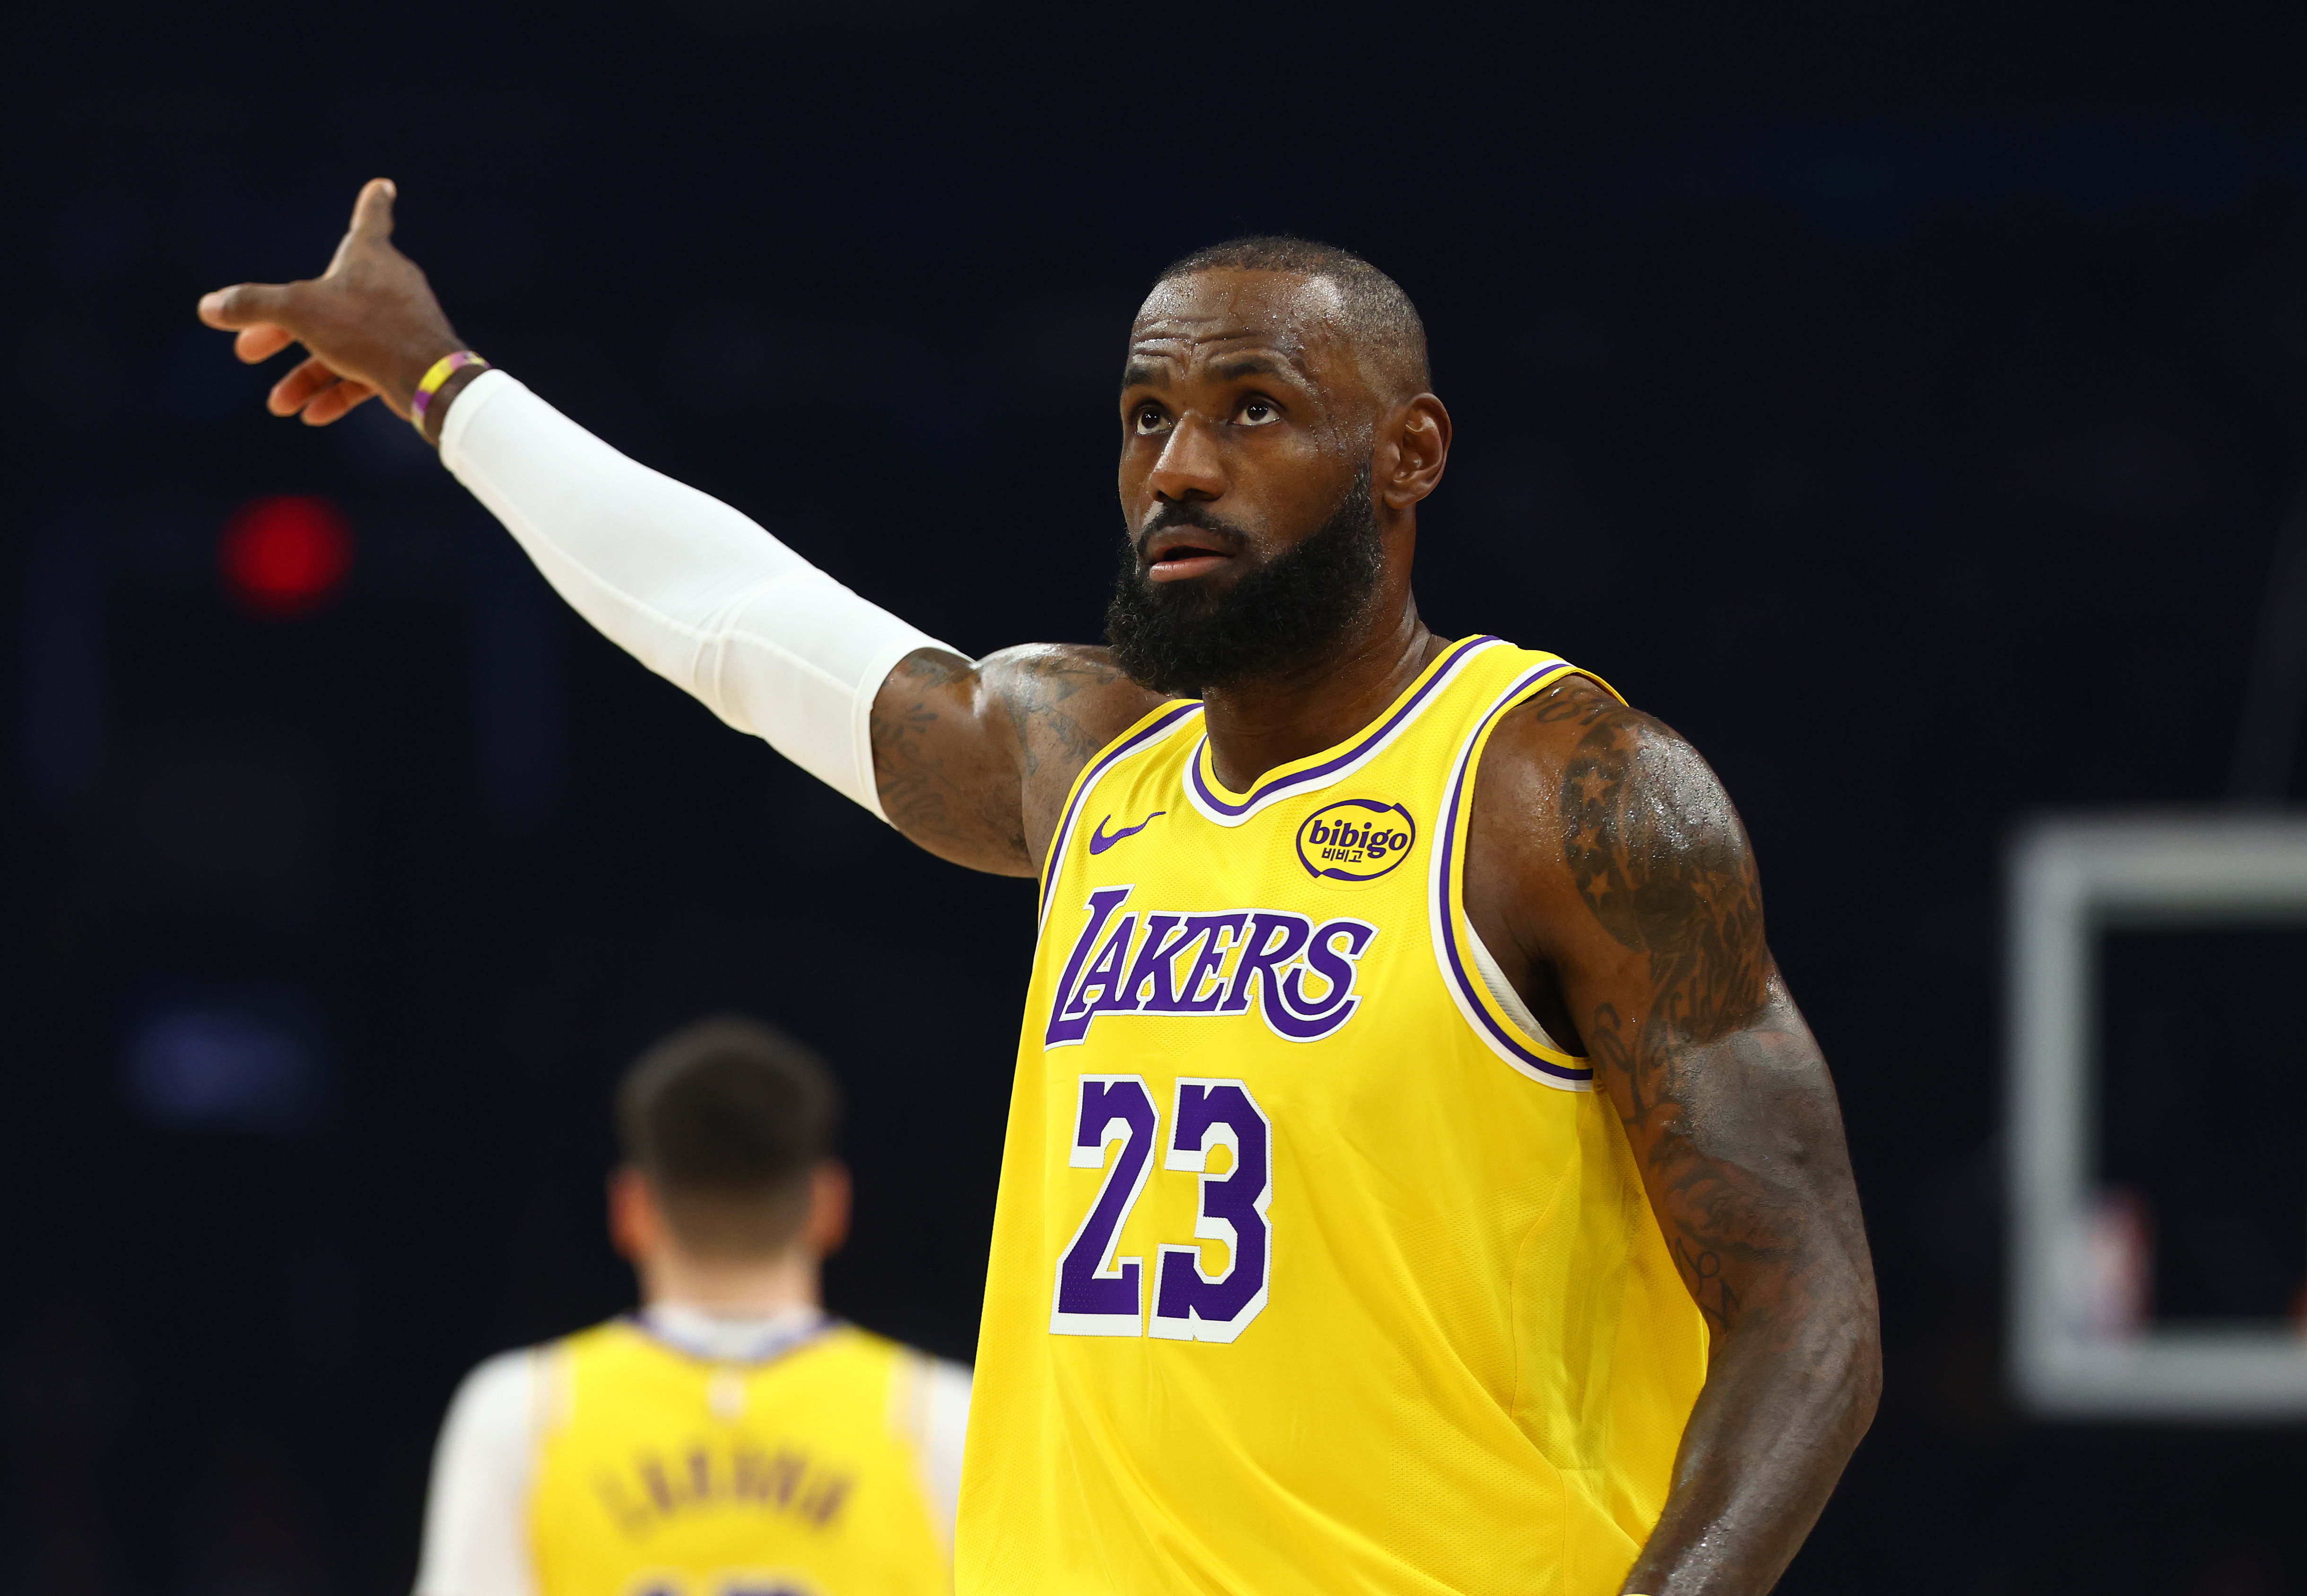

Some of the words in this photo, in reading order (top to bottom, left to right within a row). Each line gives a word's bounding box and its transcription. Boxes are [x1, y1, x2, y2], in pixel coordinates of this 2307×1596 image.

[1309, 820, 1408, 858] bibigo
[1322, 847, 1363, 863] 비비고
[1044, 884, 1379, 1052] LAKERS
[1049, 1074, 1273, 1344] 23
